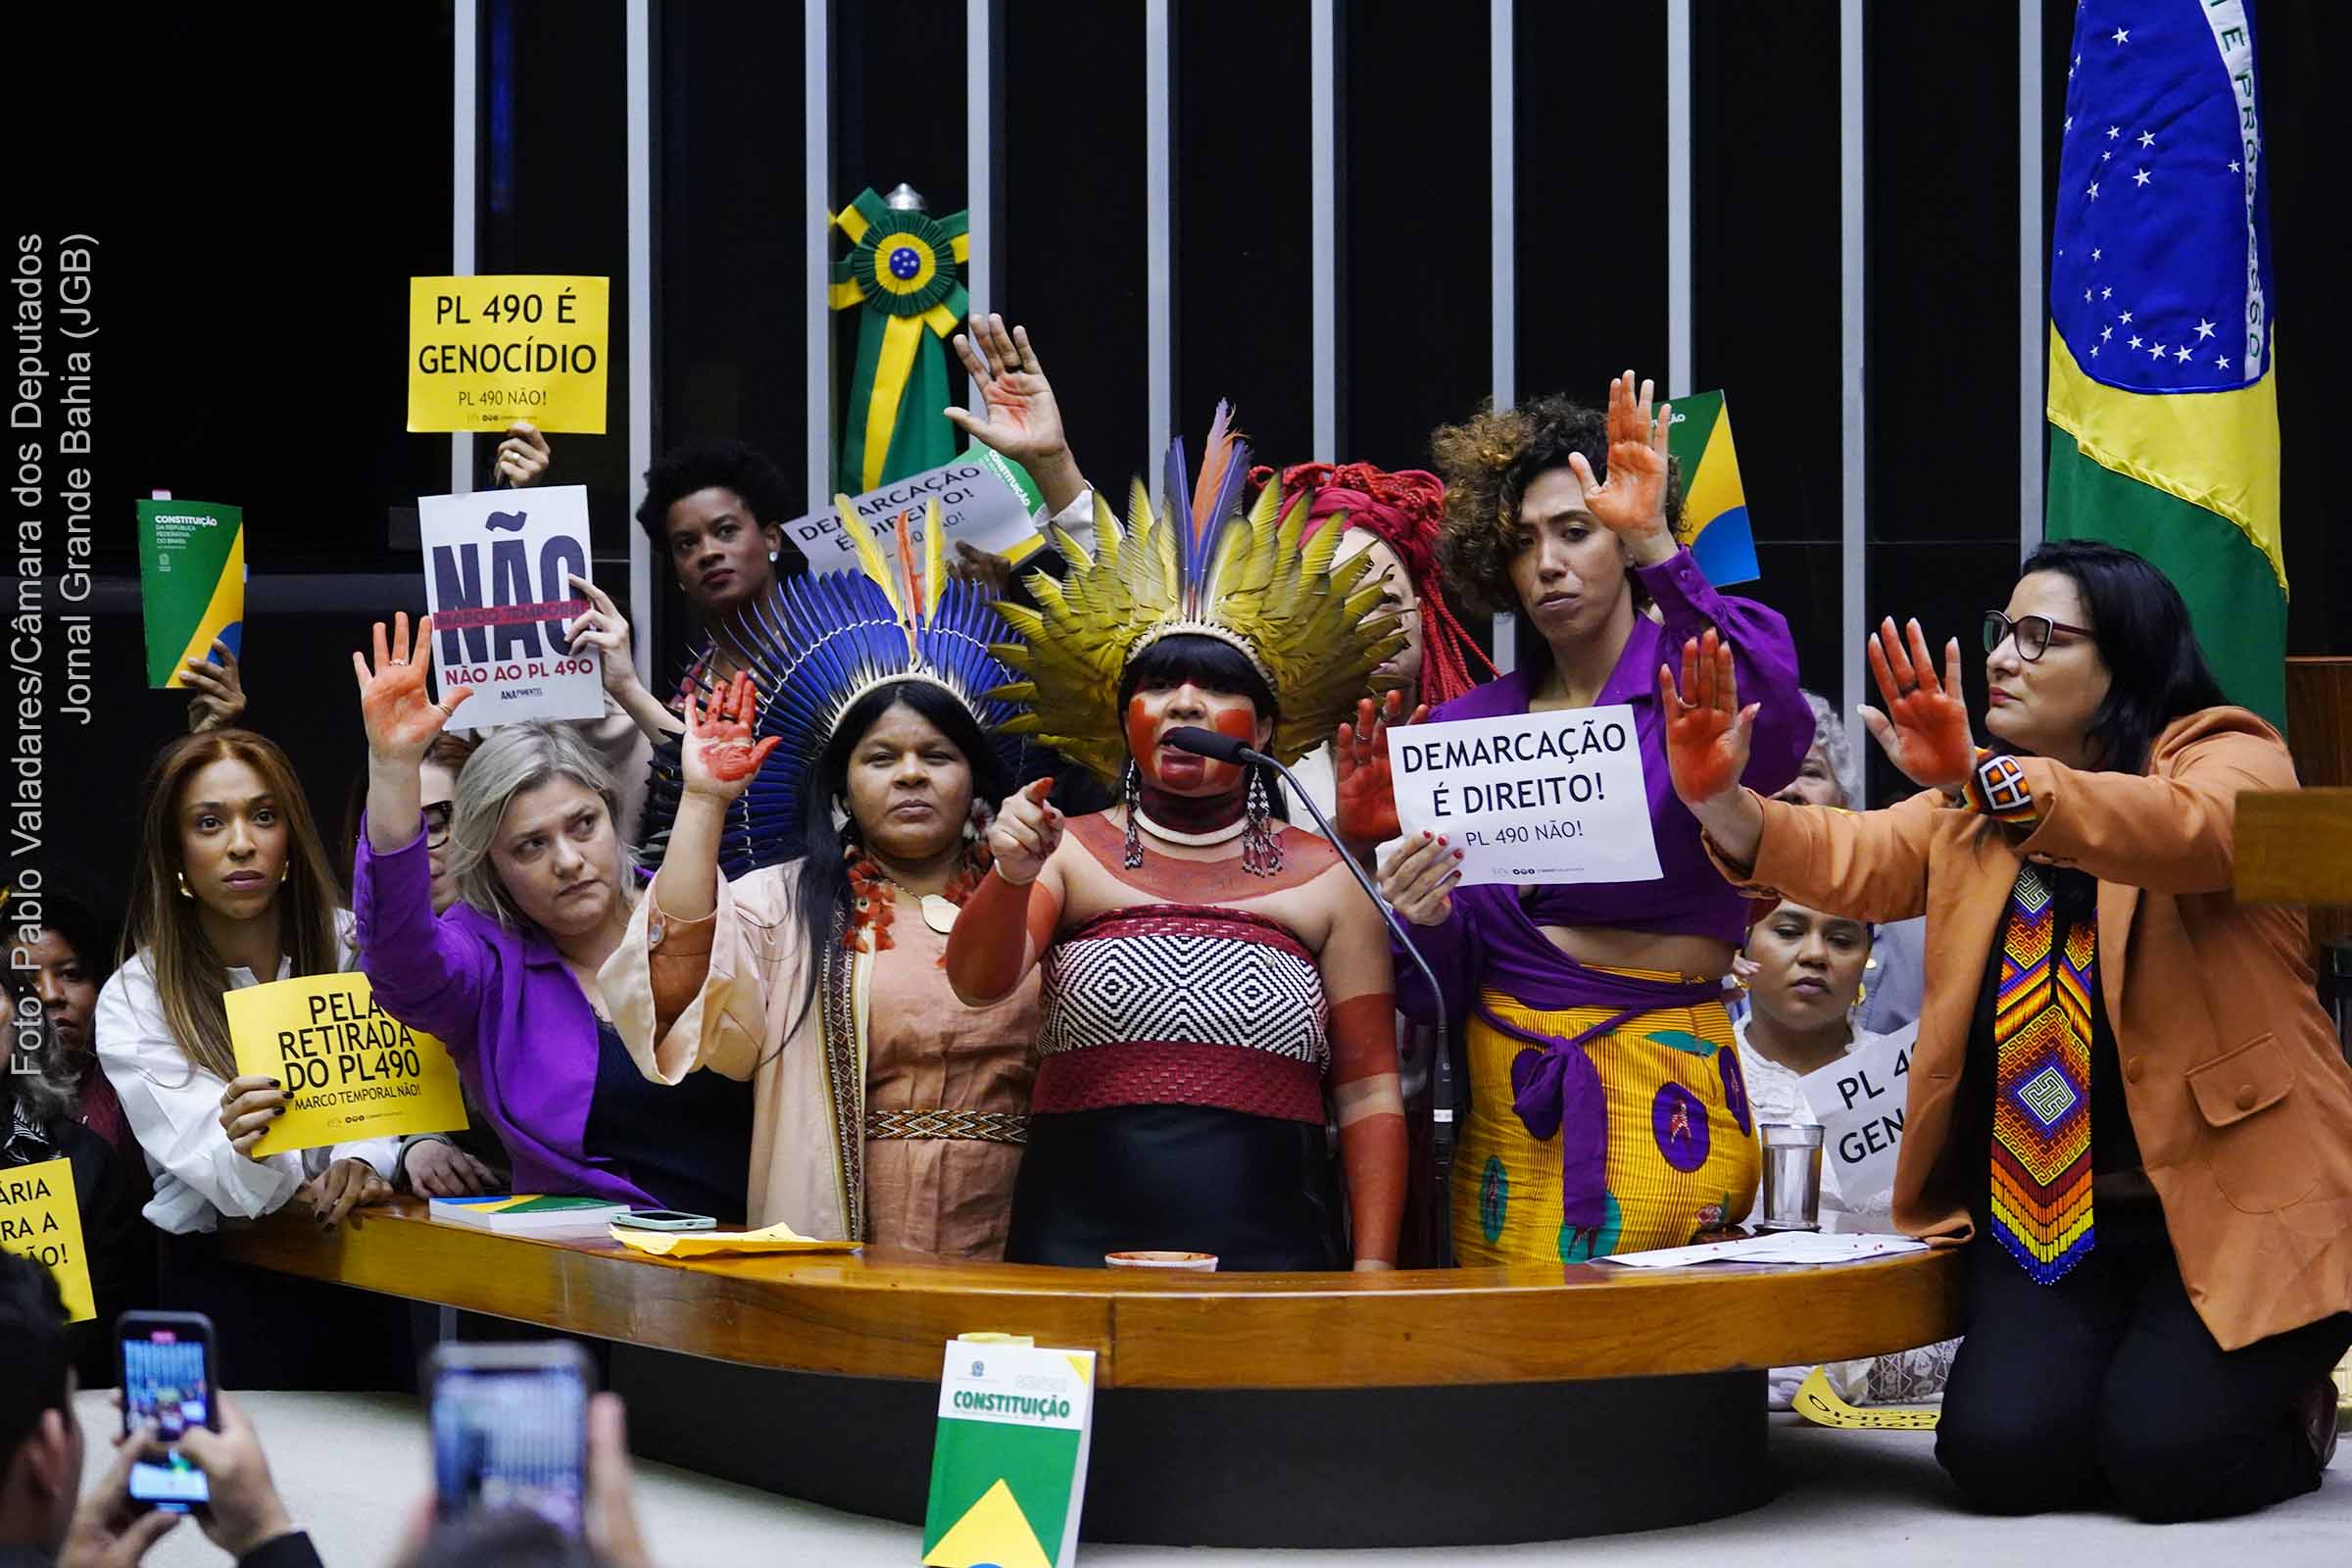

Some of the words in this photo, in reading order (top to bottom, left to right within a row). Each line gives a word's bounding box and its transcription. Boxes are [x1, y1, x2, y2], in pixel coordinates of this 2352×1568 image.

[2221, 26, 2245, 52] E
[2234, 71, 2261, 359] PROGSSO
[436, 295, 471, 325] PL
[482, 293, 543, 324] 490
[558, 286, 577, 324] É
[418, 335, 597, 374] GENOCÍDIO
[459, 391, 475, 407] PL
[479, 390, 504, 406] 490
[508, 388, 547, 406] NÃO!
[977, 449, 1031, 507] CONSTITUIÇÃO
[155, 515, 218, 527] CONSTITUIÇÃO
[432, 511, 587, 666] NÃO
[445, 665, 488, 685] NÃO
[494, 664, 522, 682] AO
[528, 662, 549, 678] PL
[554, 658, 594, 676] 490
[1402, 719, 1626, 774] DEMARCAÇÃO
[1433, 782, 1451, 817] É
[1463, 772, 1605, 814] DIREITO!
[1466, 832, 1490, 846] PL
[1494, 826, 1529, 845] 490
[1535, 820, 1584, 842] NÃO!
[309, 991, 385, 1024] PELA
[277, 1022, 416, 1061] RETIRADA
[284, 1058, 330, 1092] DO
[1837, 1069, 1886, 1110] PL
[1893, 1041, 1917, 1077] 4
[295, 1093, 337, 1111] MARCO
[339, 1086, 397, 1104] TEMPORAL
[397, 1082, 422, 1099] NÃO!
[42, 1210, 60, 1233] A
[954, 1390, 1071, 1421] CONSTITUIÇÃO
